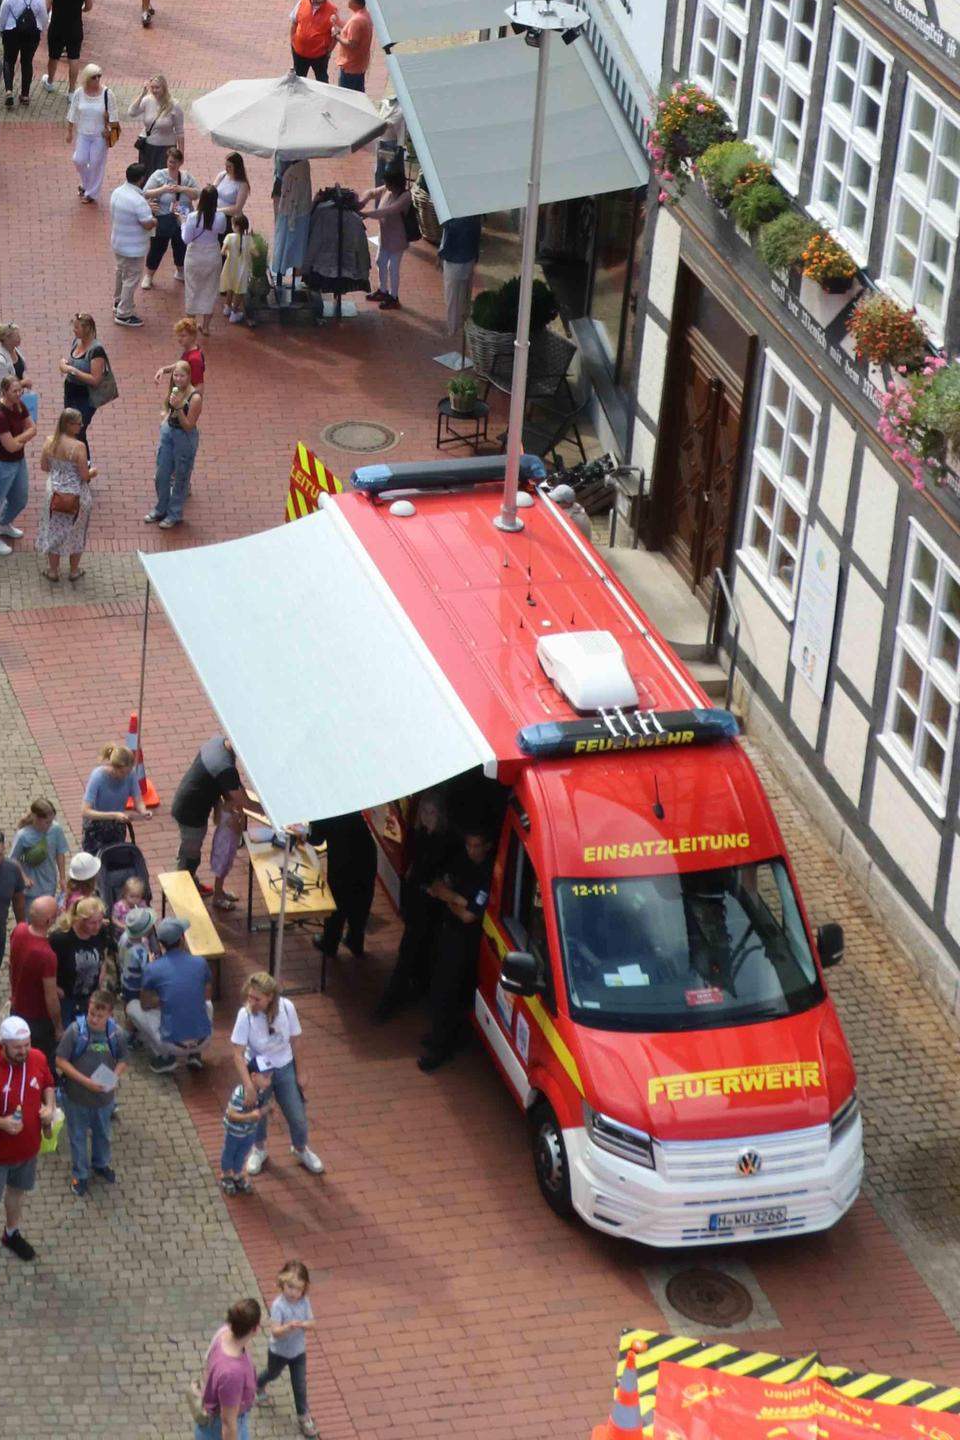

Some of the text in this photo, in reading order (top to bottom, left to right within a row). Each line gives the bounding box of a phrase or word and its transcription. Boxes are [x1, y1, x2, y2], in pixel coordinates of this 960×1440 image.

[584, 833, 750, 863] EINSATZLEITUNG
[572, 884, 618, 896] 12-11-1
[648, 1069, 821, 1105] FEUERWEHR
[764, 1386, 811, 1401] halten
